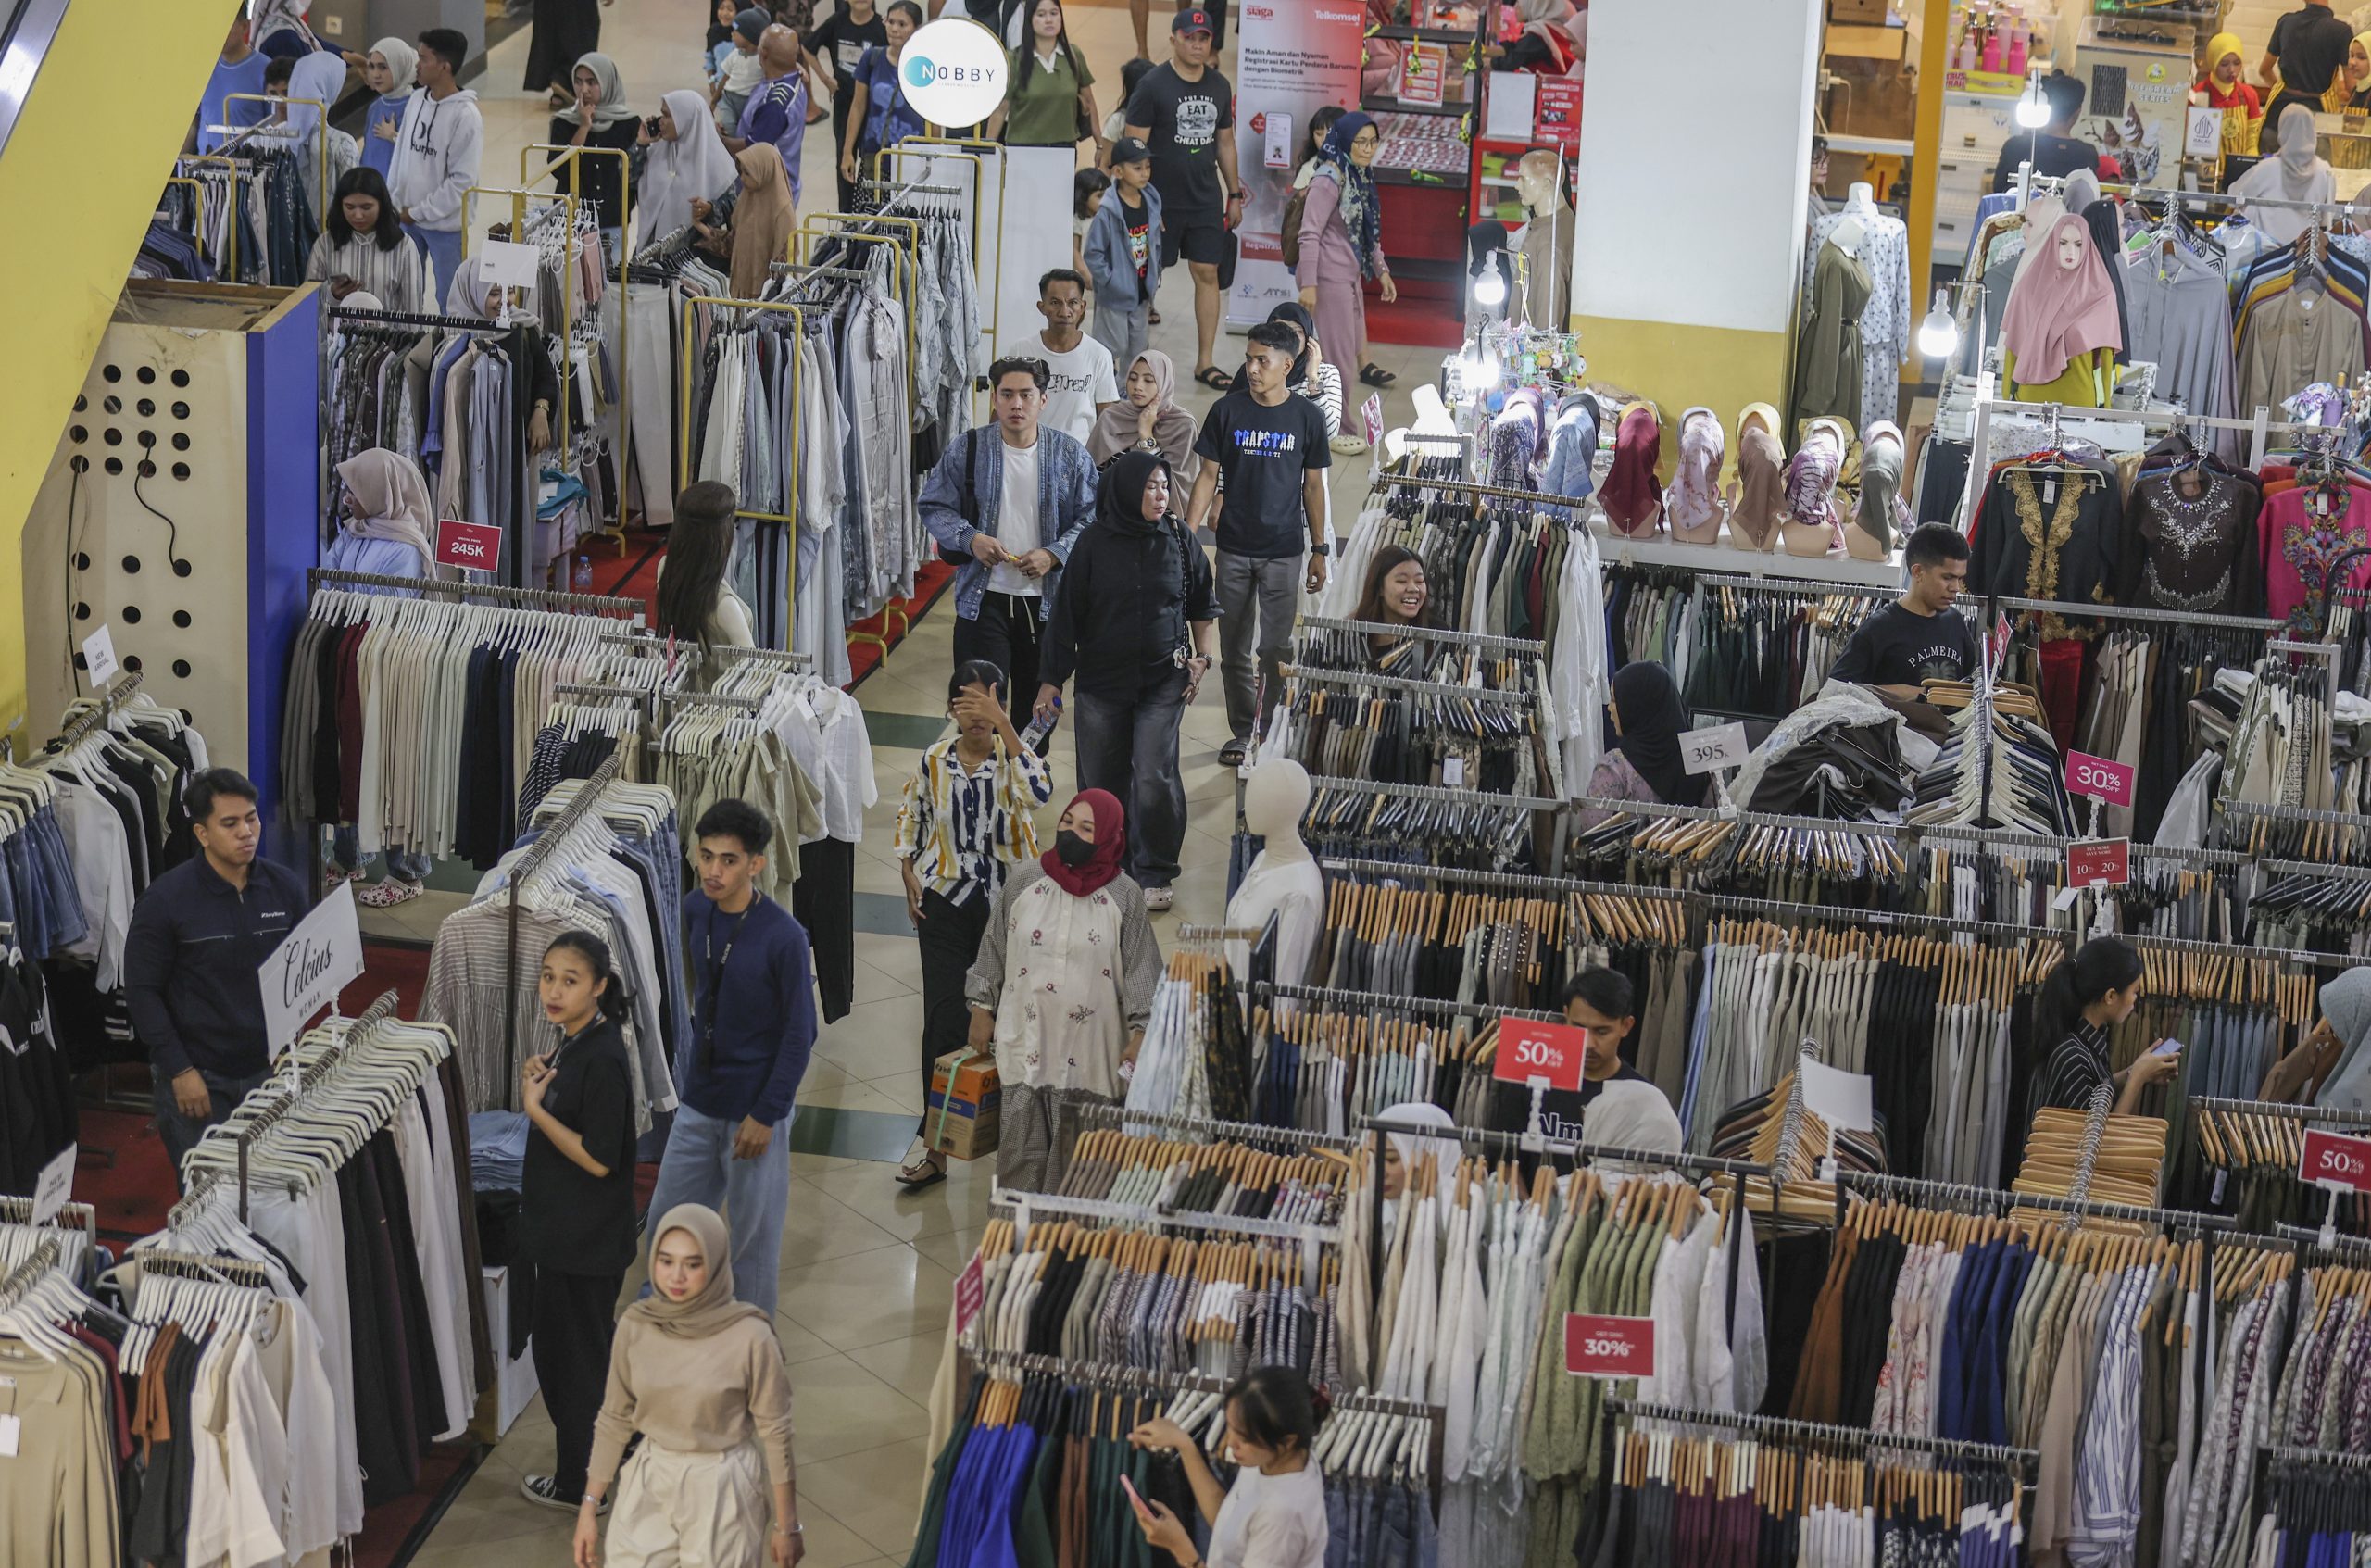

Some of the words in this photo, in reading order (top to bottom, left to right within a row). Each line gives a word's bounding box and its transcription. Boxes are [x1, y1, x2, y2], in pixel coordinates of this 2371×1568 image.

[1315, 10, 1361, 21] Telkomsel
[1244, 56, 1279, 66] Registrasi
[1300, 61, 1328, 69] Perdana
[1301, 52, 1329, 60] Nyaman
[922, 64, 995, 82] NOBBY
[1244, 66, 1270, 74] dengan
[1271, 67, 1304, 75] Biometrik
[1187, 104, 1207, 115] EAT
[1174, 134, 1198, 145] CHEAT
[1234, 429, 1296, 451] TRAPSTAR
[451, 542, 485, 558] 245K
[1908, 646, 1963, 668] PALMEIRA
[2076, 765, 2121, 789] 30%
[2105, 784, 2120, 793] OFF
[283, 937, 333, 1009] Celcius
[298, 990, 321, 1018] WOMAN
[1514, 1039, 1564, 1066] 50%
[2319, 1149, 2365, 1172] 50%
[1584, 1338, 1630, 1358] 30%
